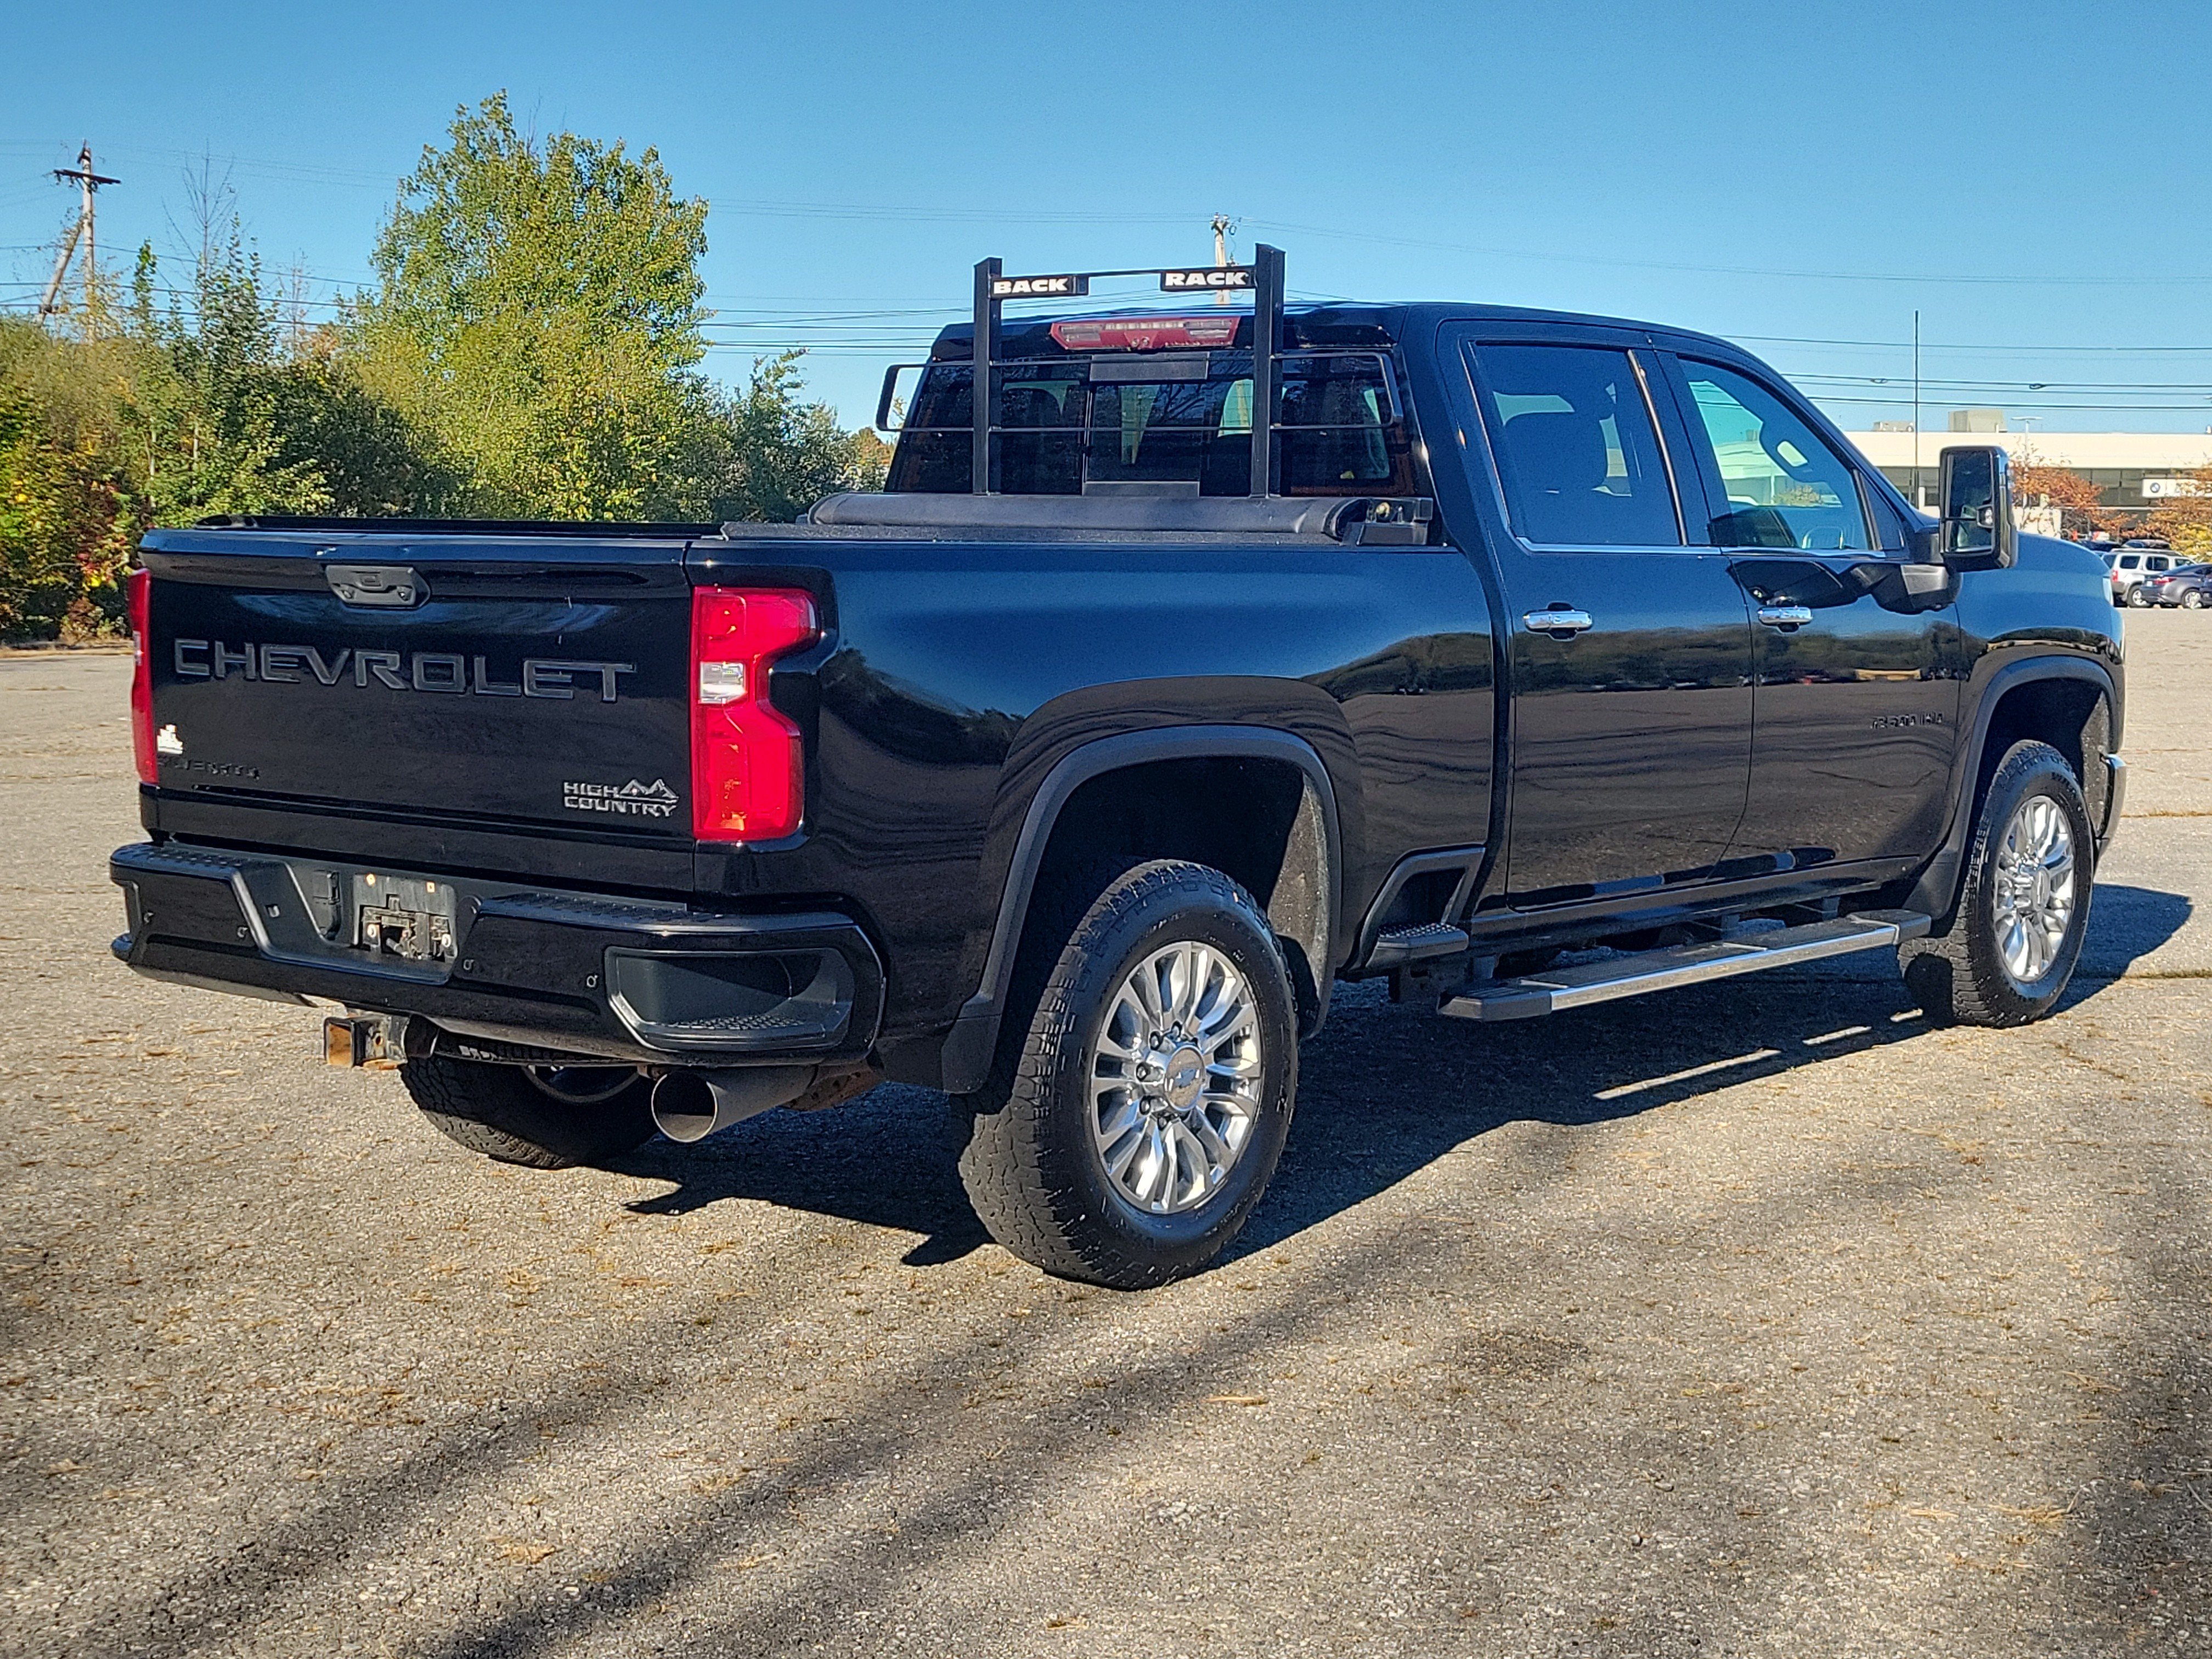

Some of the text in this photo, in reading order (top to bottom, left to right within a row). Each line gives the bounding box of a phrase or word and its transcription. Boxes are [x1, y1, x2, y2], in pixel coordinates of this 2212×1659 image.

[993, 272, 1244, 294] BACK RACK
[174, 638, 637, 702] CHEVROLET
[563, 782, 619, 797] HIGH
[564, 796, 676, 817] COUNTRY
